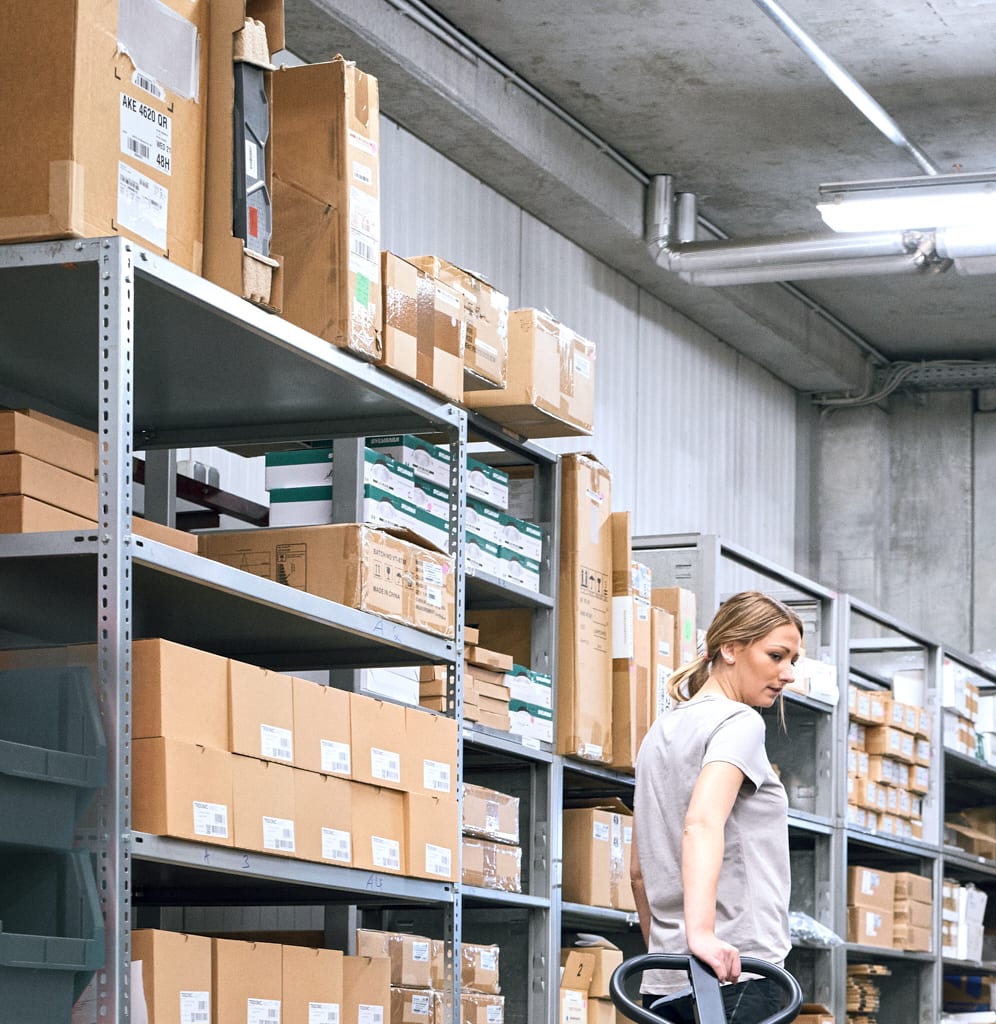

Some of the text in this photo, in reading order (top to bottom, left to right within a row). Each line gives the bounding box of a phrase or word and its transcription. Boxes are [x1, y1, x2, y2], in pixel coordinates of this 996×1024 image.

[122, 95, 137, 112] AKE
[139, 104, 156, 123] 4620
[156, 153, 170, 170] 48H
[241, 854, 250, 869] 3
[576, 963, 583, 977] 2
